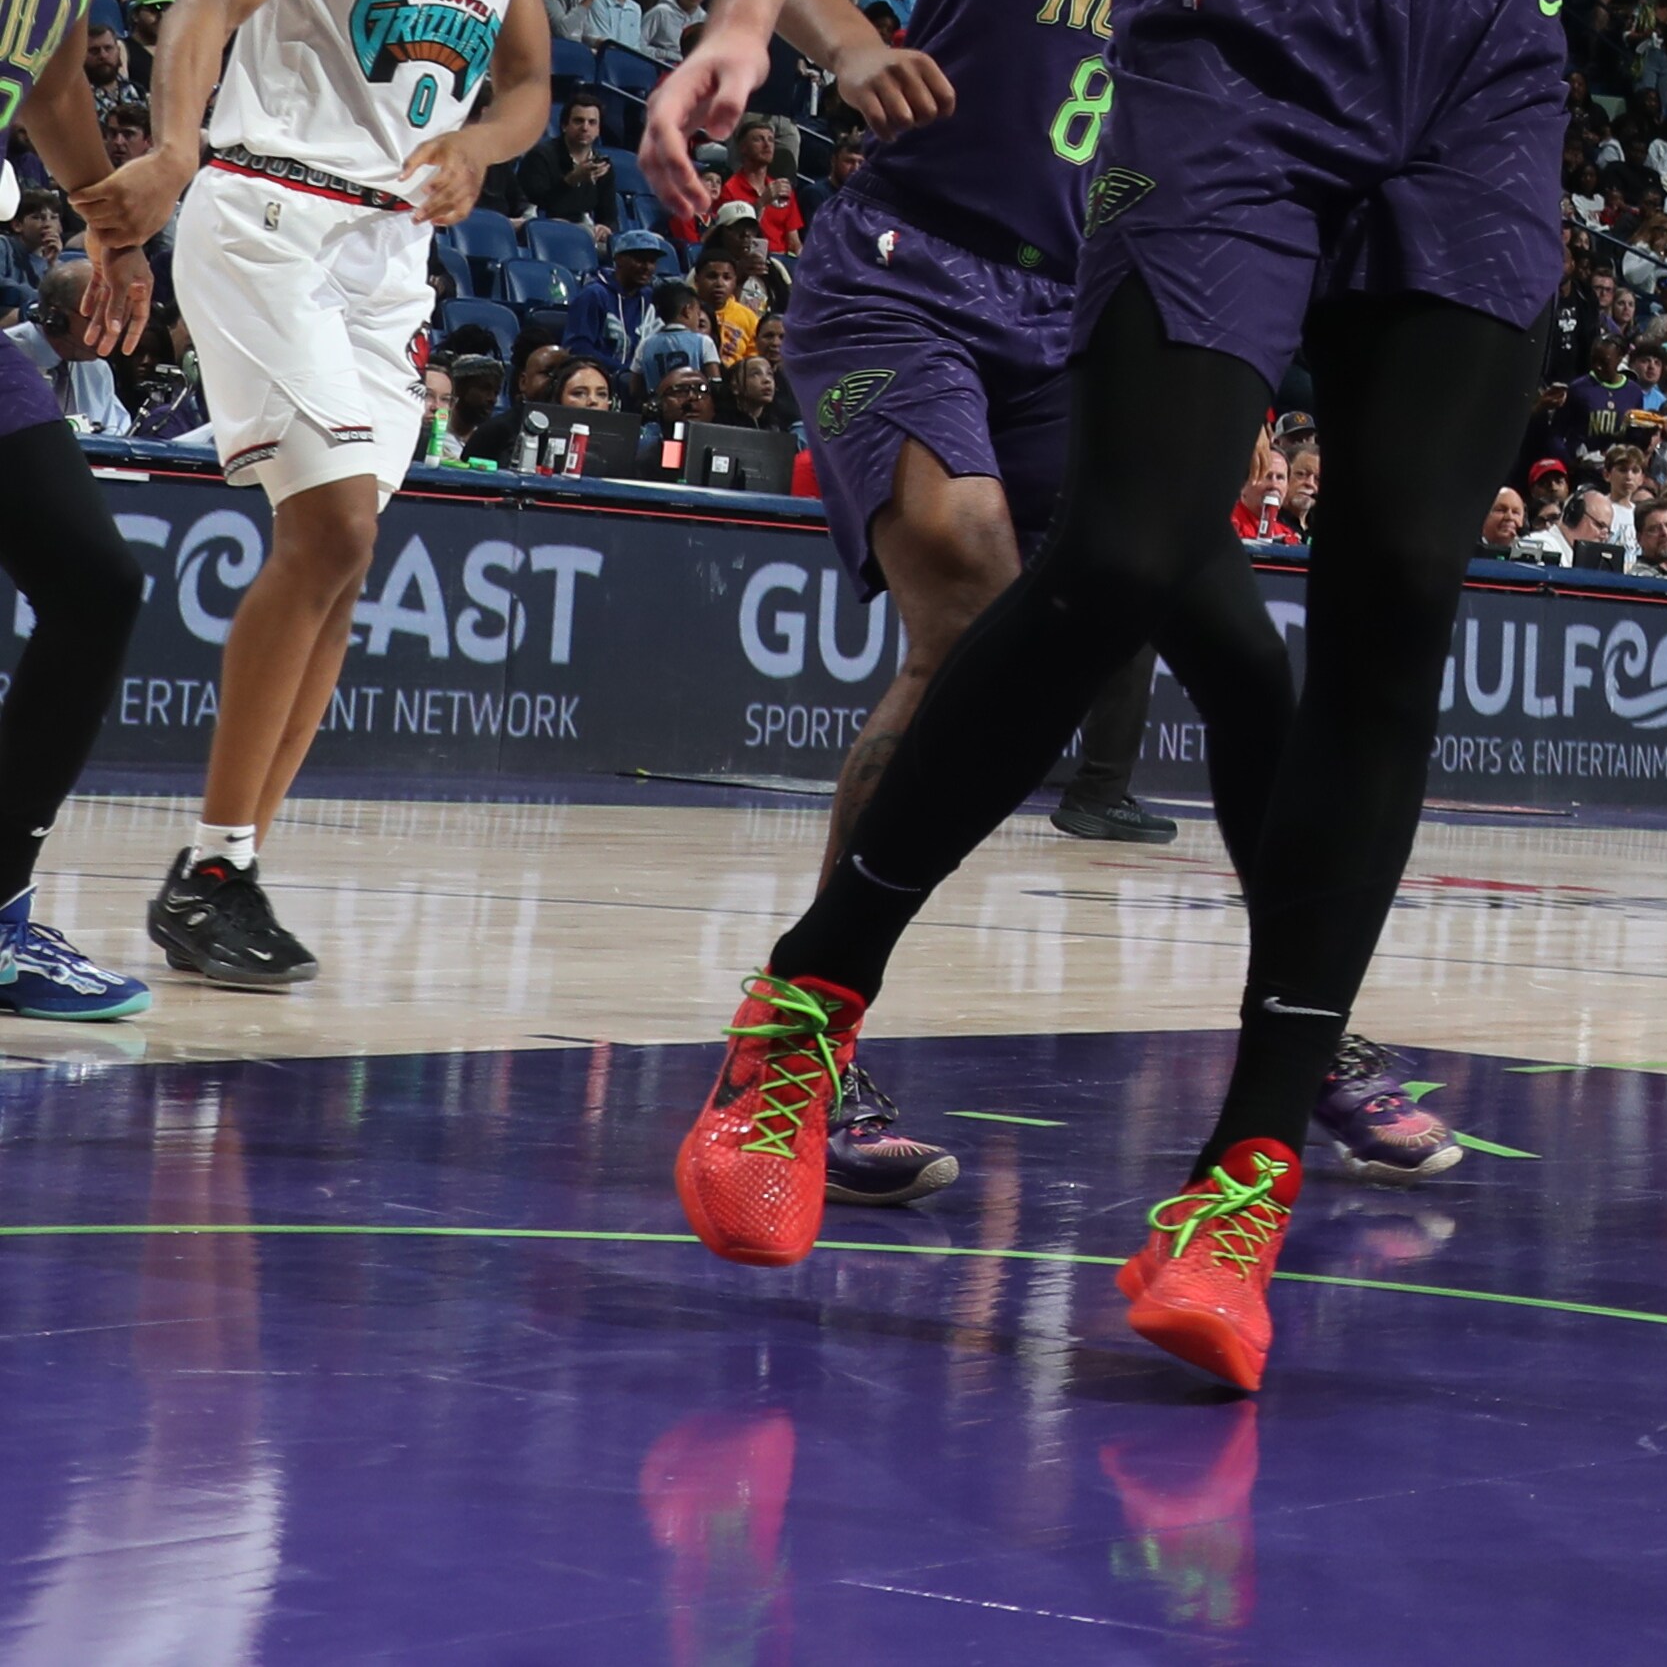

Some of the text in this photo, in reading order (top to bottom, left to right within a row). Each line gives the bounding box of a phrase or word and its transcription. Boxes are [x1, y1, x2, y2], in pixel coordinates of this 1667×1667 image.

[406, 72, 439, 129] 0
[393, 689, 580, 739] NETWORK
[1430, 733, 1502, 776] PORTS
[1508, 744, 1527, 775] &
